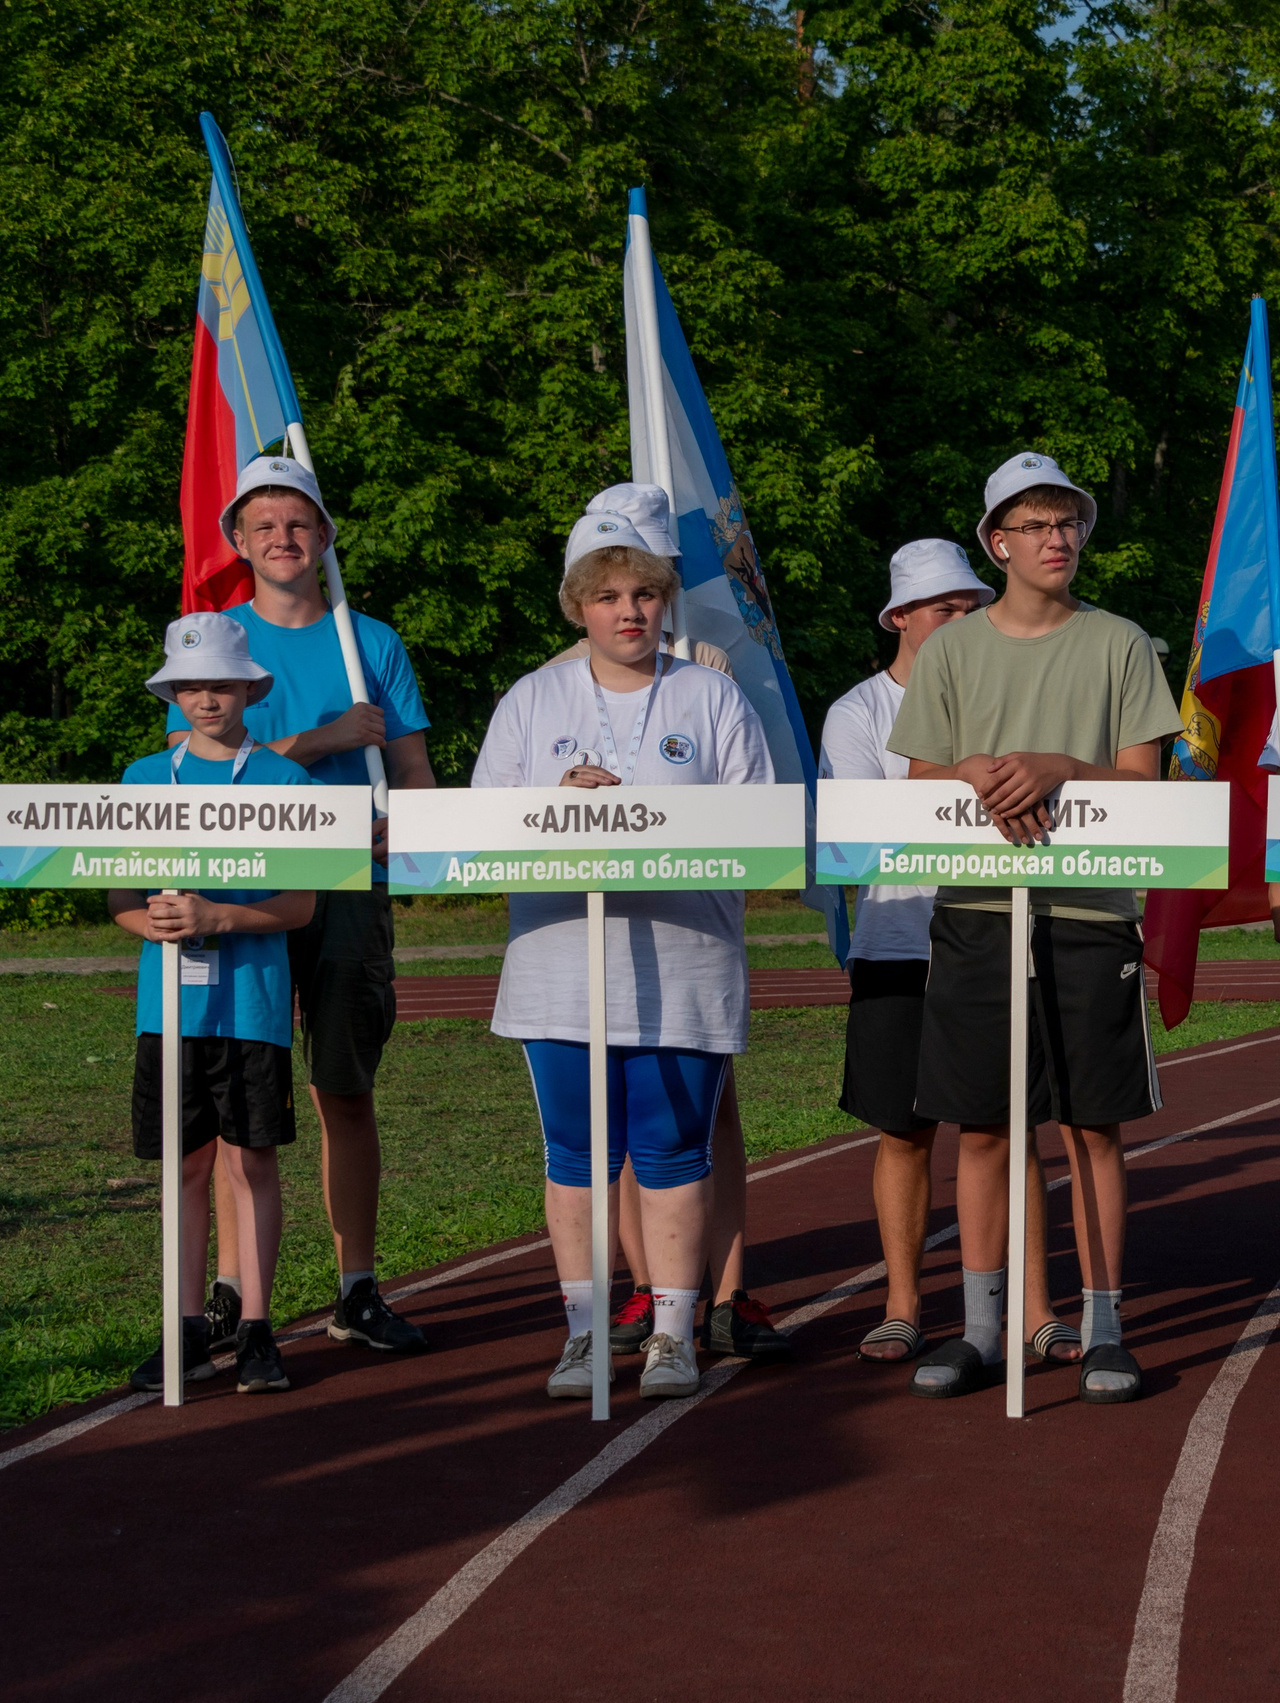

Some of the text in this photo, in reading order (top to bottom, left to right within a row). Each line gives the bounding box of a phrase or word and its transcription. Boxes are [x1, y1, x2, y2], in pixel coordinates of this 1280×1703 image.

[7, 795, 337, 831] «АЛТАЙСКИЕ СОРОКИ»
[523, 803, 667, 834] «АЛМАЗ»
[935, 799, 1108, 828] «КВИТ»
[71, 851, 266, 883] Алтайский край
[446, 853, 747, 882] Архангельская область
[880, 848, 1164, 880] Белгородская область
